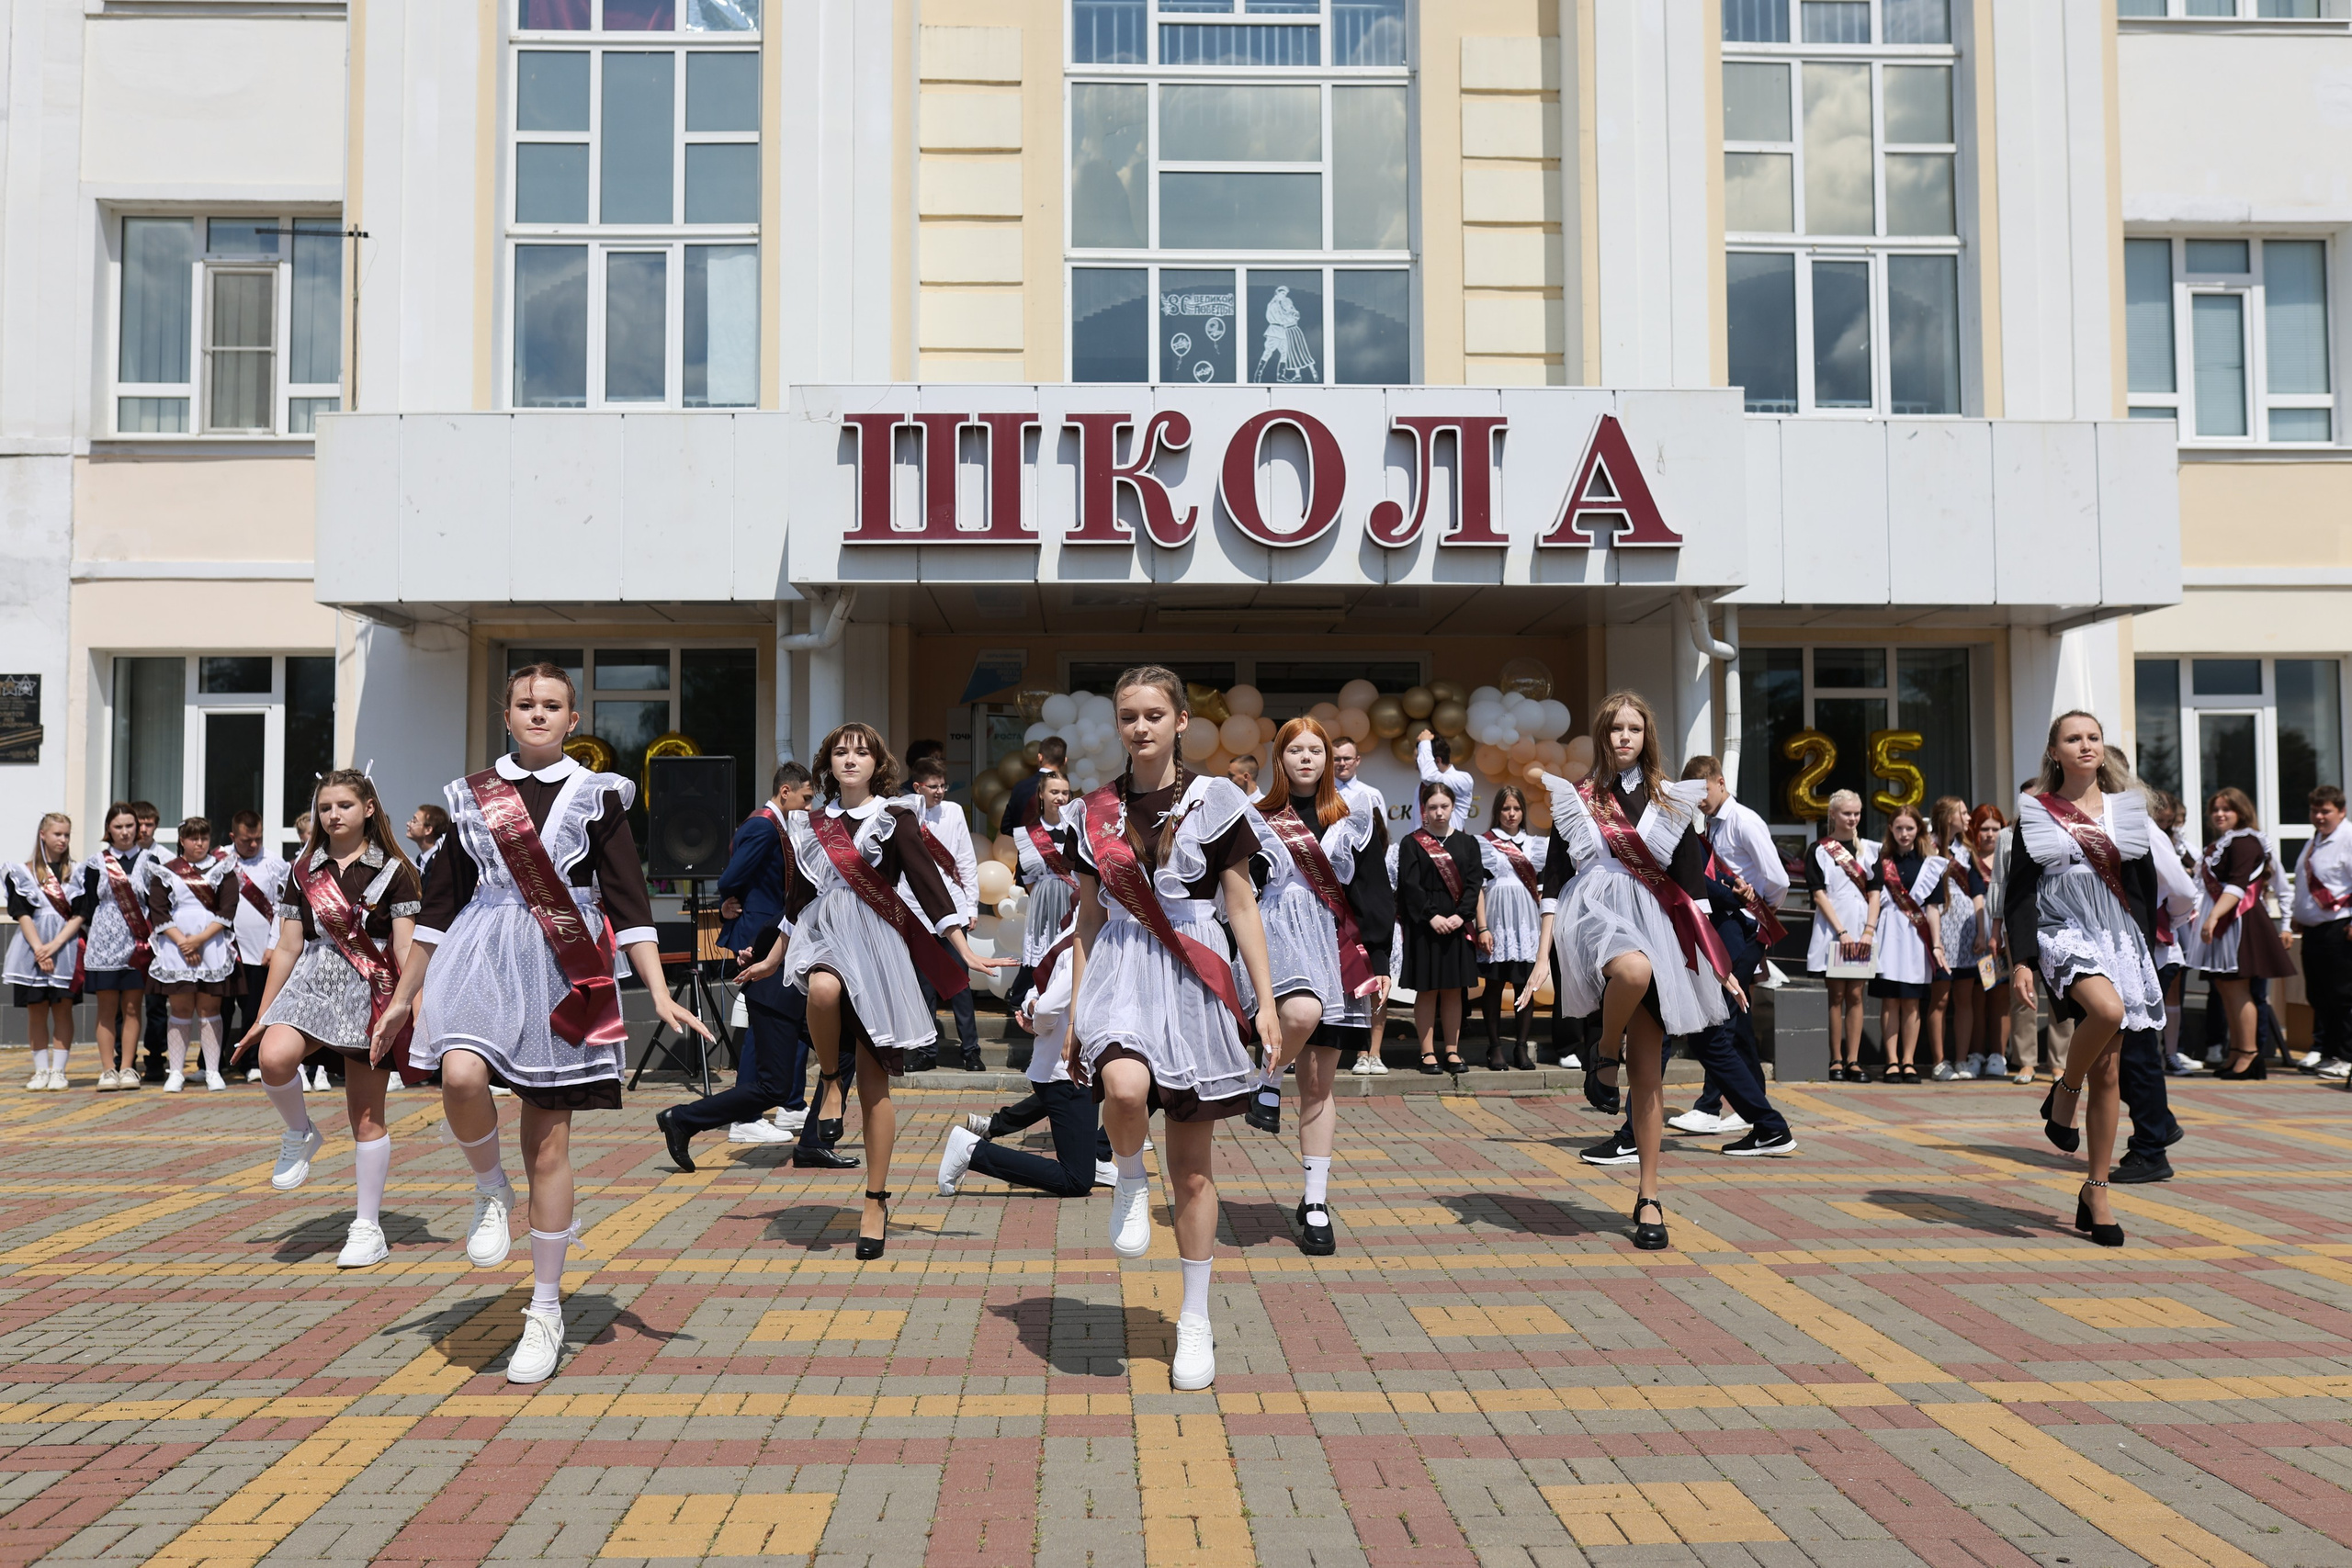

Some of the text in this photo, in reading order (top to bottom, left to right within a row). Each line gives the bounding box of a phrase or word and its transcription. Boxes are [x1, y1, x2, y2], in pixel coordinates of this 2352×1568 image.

[1193, 293, 1234, 304] ВЕЛИКОЙ
[842, 410, 1684, 548] ШКОЛА
[993, 732, 1023, 741] РОСТА
[1783, 727, 1926, 821] 25
[490, 796, 588, 943] Выпускница 2025
[828, 834, 890, 908] Выпускница
